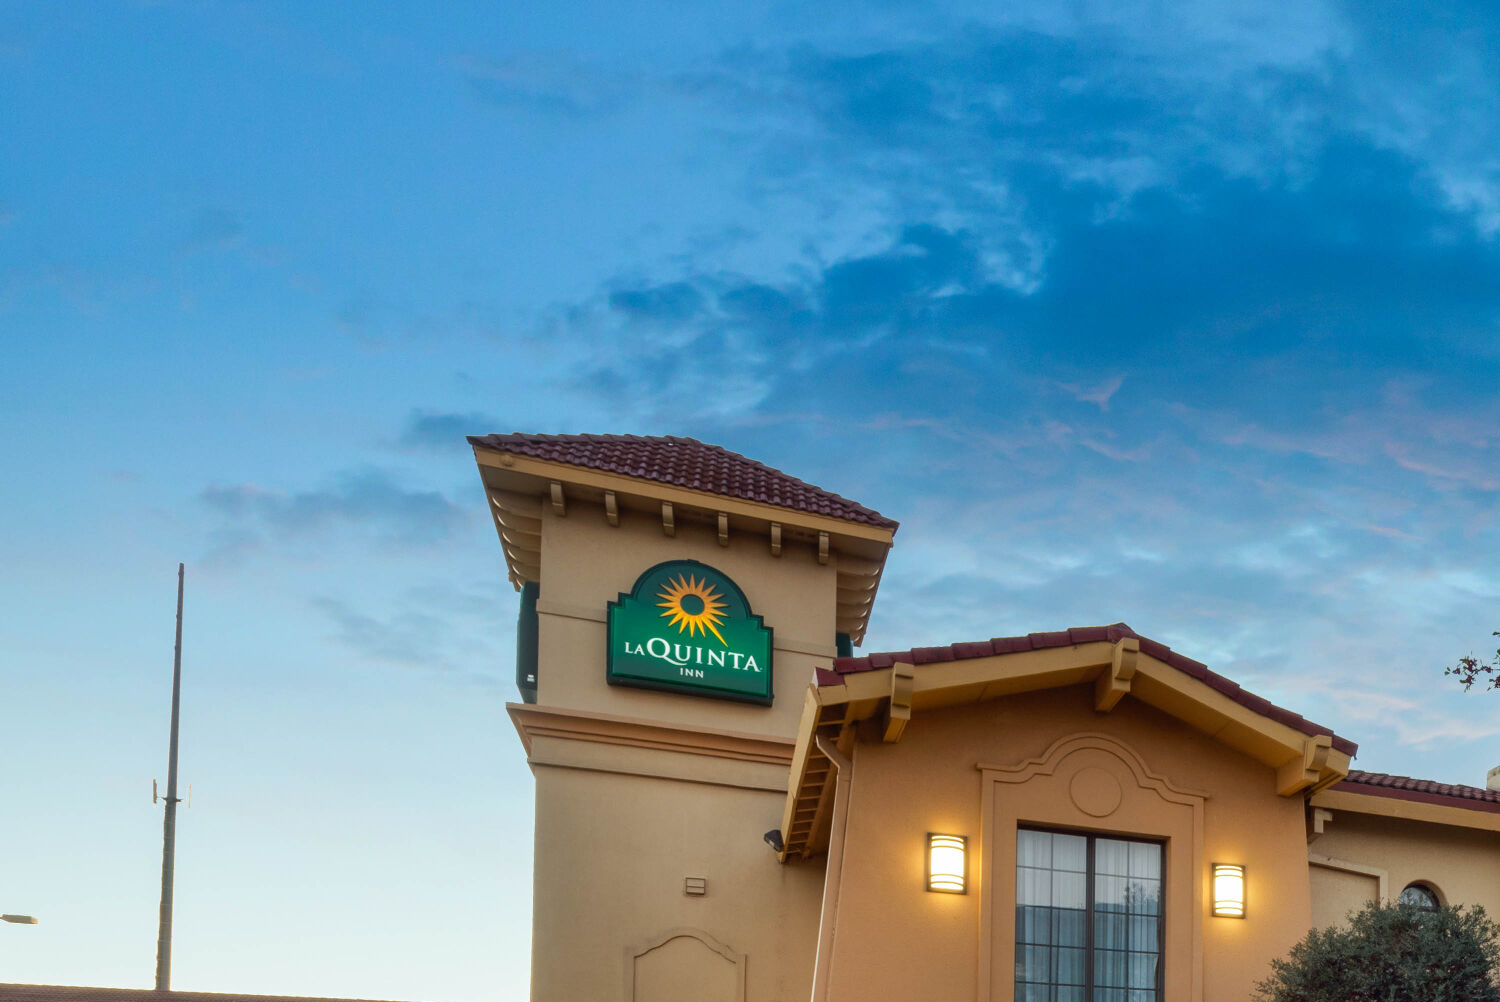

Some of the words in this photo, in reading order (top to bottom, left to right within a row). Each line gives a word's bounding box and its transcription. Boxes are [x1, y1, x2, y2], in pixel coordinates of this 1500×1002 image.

[624, 641, 645, 656] LA
[646, 637, 761, 672] QUINTA
[680, 667, 704, 678] INN
